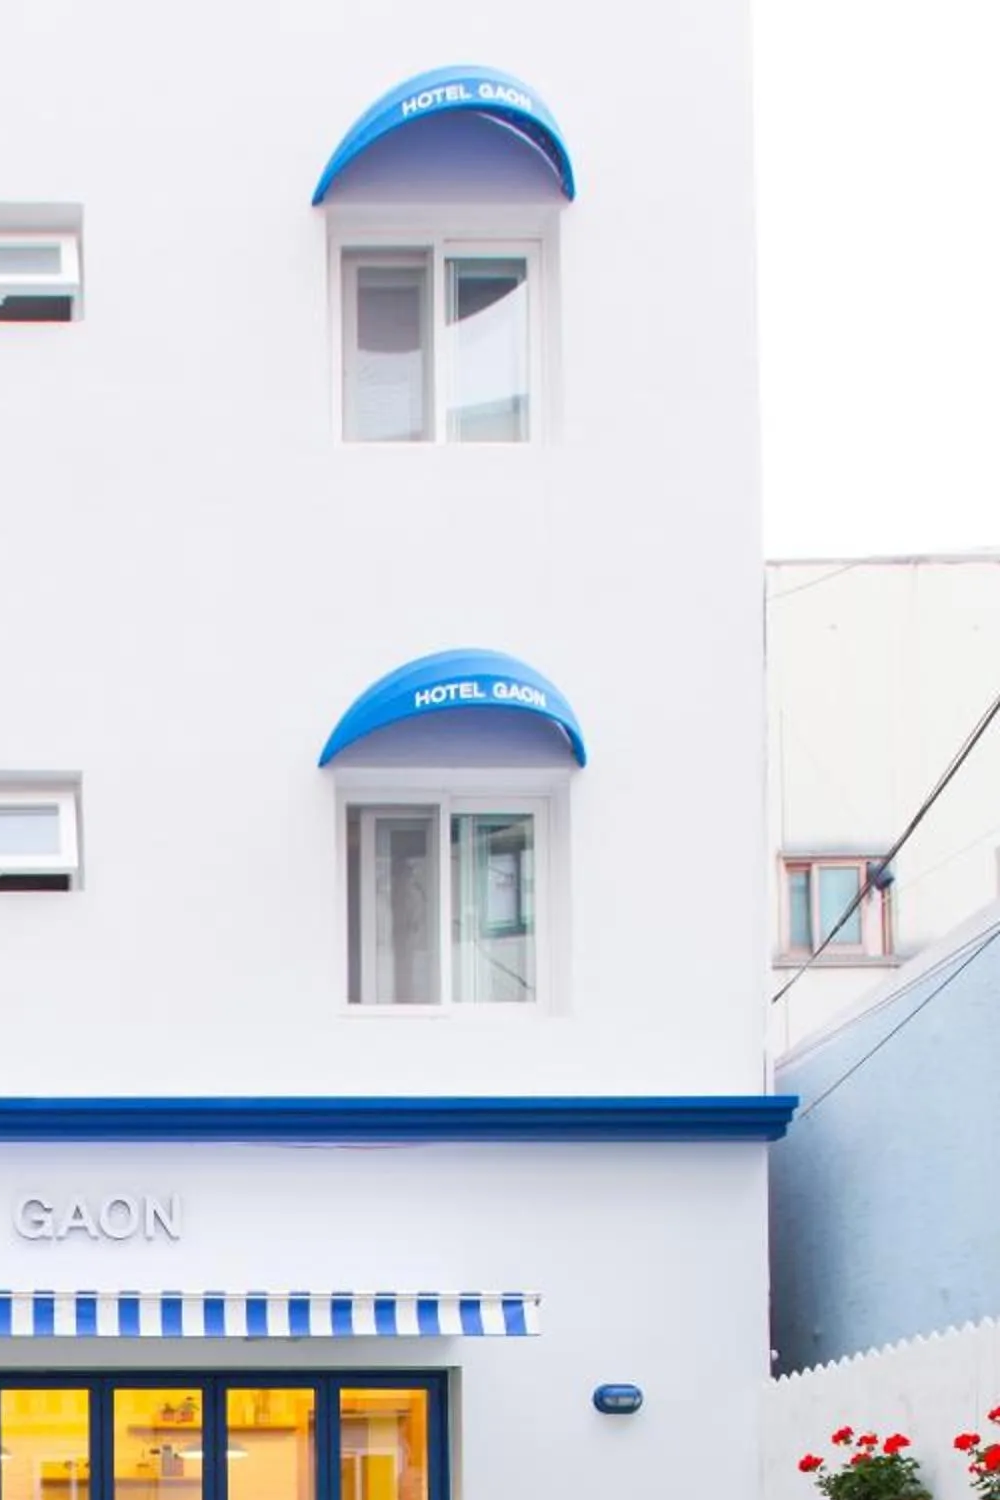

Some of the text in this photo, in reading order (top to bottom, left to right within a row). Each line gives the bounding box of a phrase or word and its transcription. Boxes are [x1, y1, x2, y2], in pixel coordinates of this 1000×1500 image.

[402, 82, 532, 117] HOTEL GAON
[415, 681, 547, 708] HOTEL GAON
[13, 1195, 181, 1241] GAON
